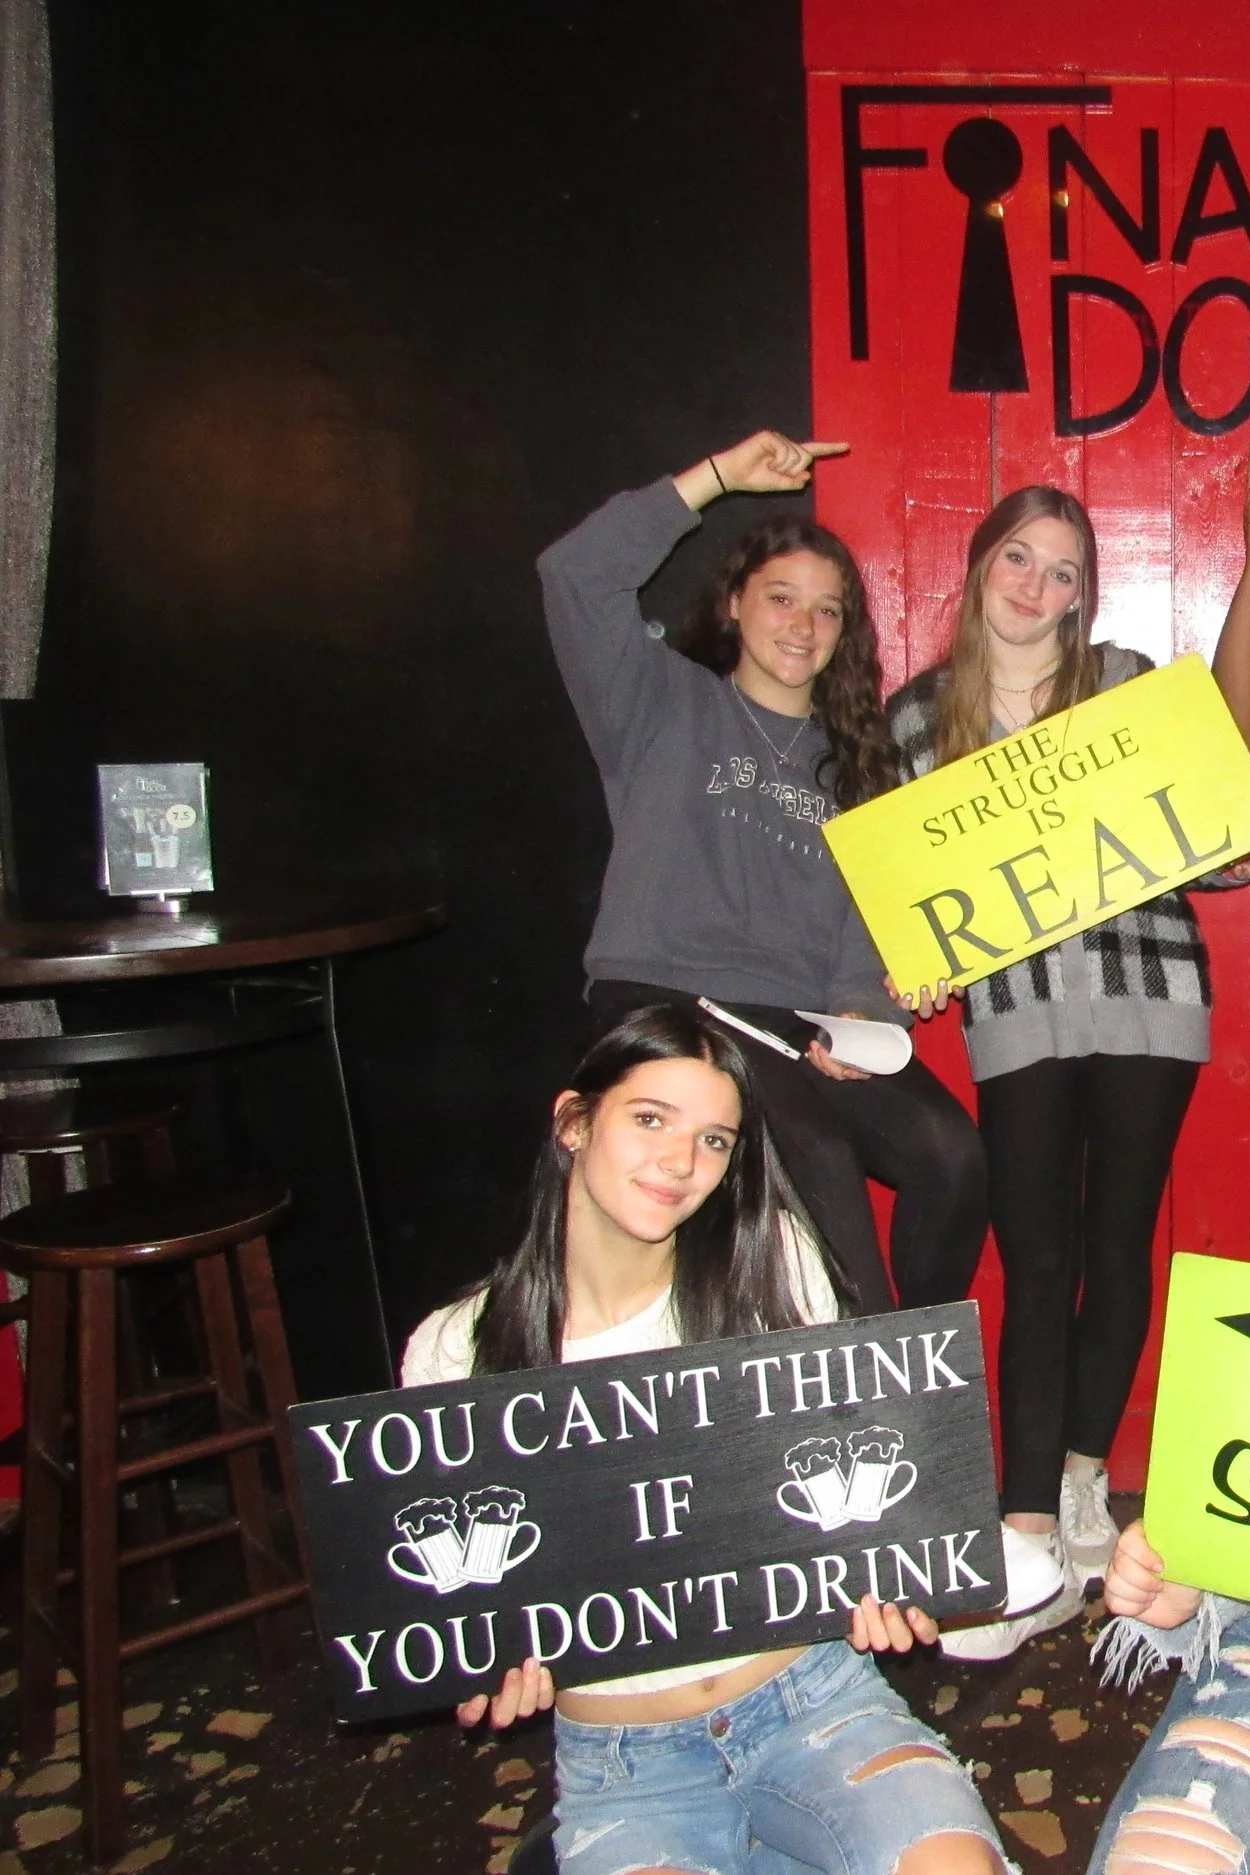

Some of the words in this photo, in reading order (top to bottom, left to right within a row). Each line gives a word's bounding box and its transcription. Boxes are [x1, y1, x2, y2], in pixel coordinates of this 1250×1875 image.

[922, 727, 1140, 848] STRUGGLE
[974, 727, 1059, 784] THE
[1026, 798, 1067, 836] IS
[908, 784, 1233, 981] REAL
[309, 1402, 477, 1485] YOU
[502, 1366, 720, 1457] CAN'T
[742, 1329, 970, 1419] THINK
[629, 1474, 694, 1542] IF
[333, 1612, 497, 1694] YOU
[520, 1570, 739, 1663] DON'T
[762, 1529, 991, 1626] DRINK
